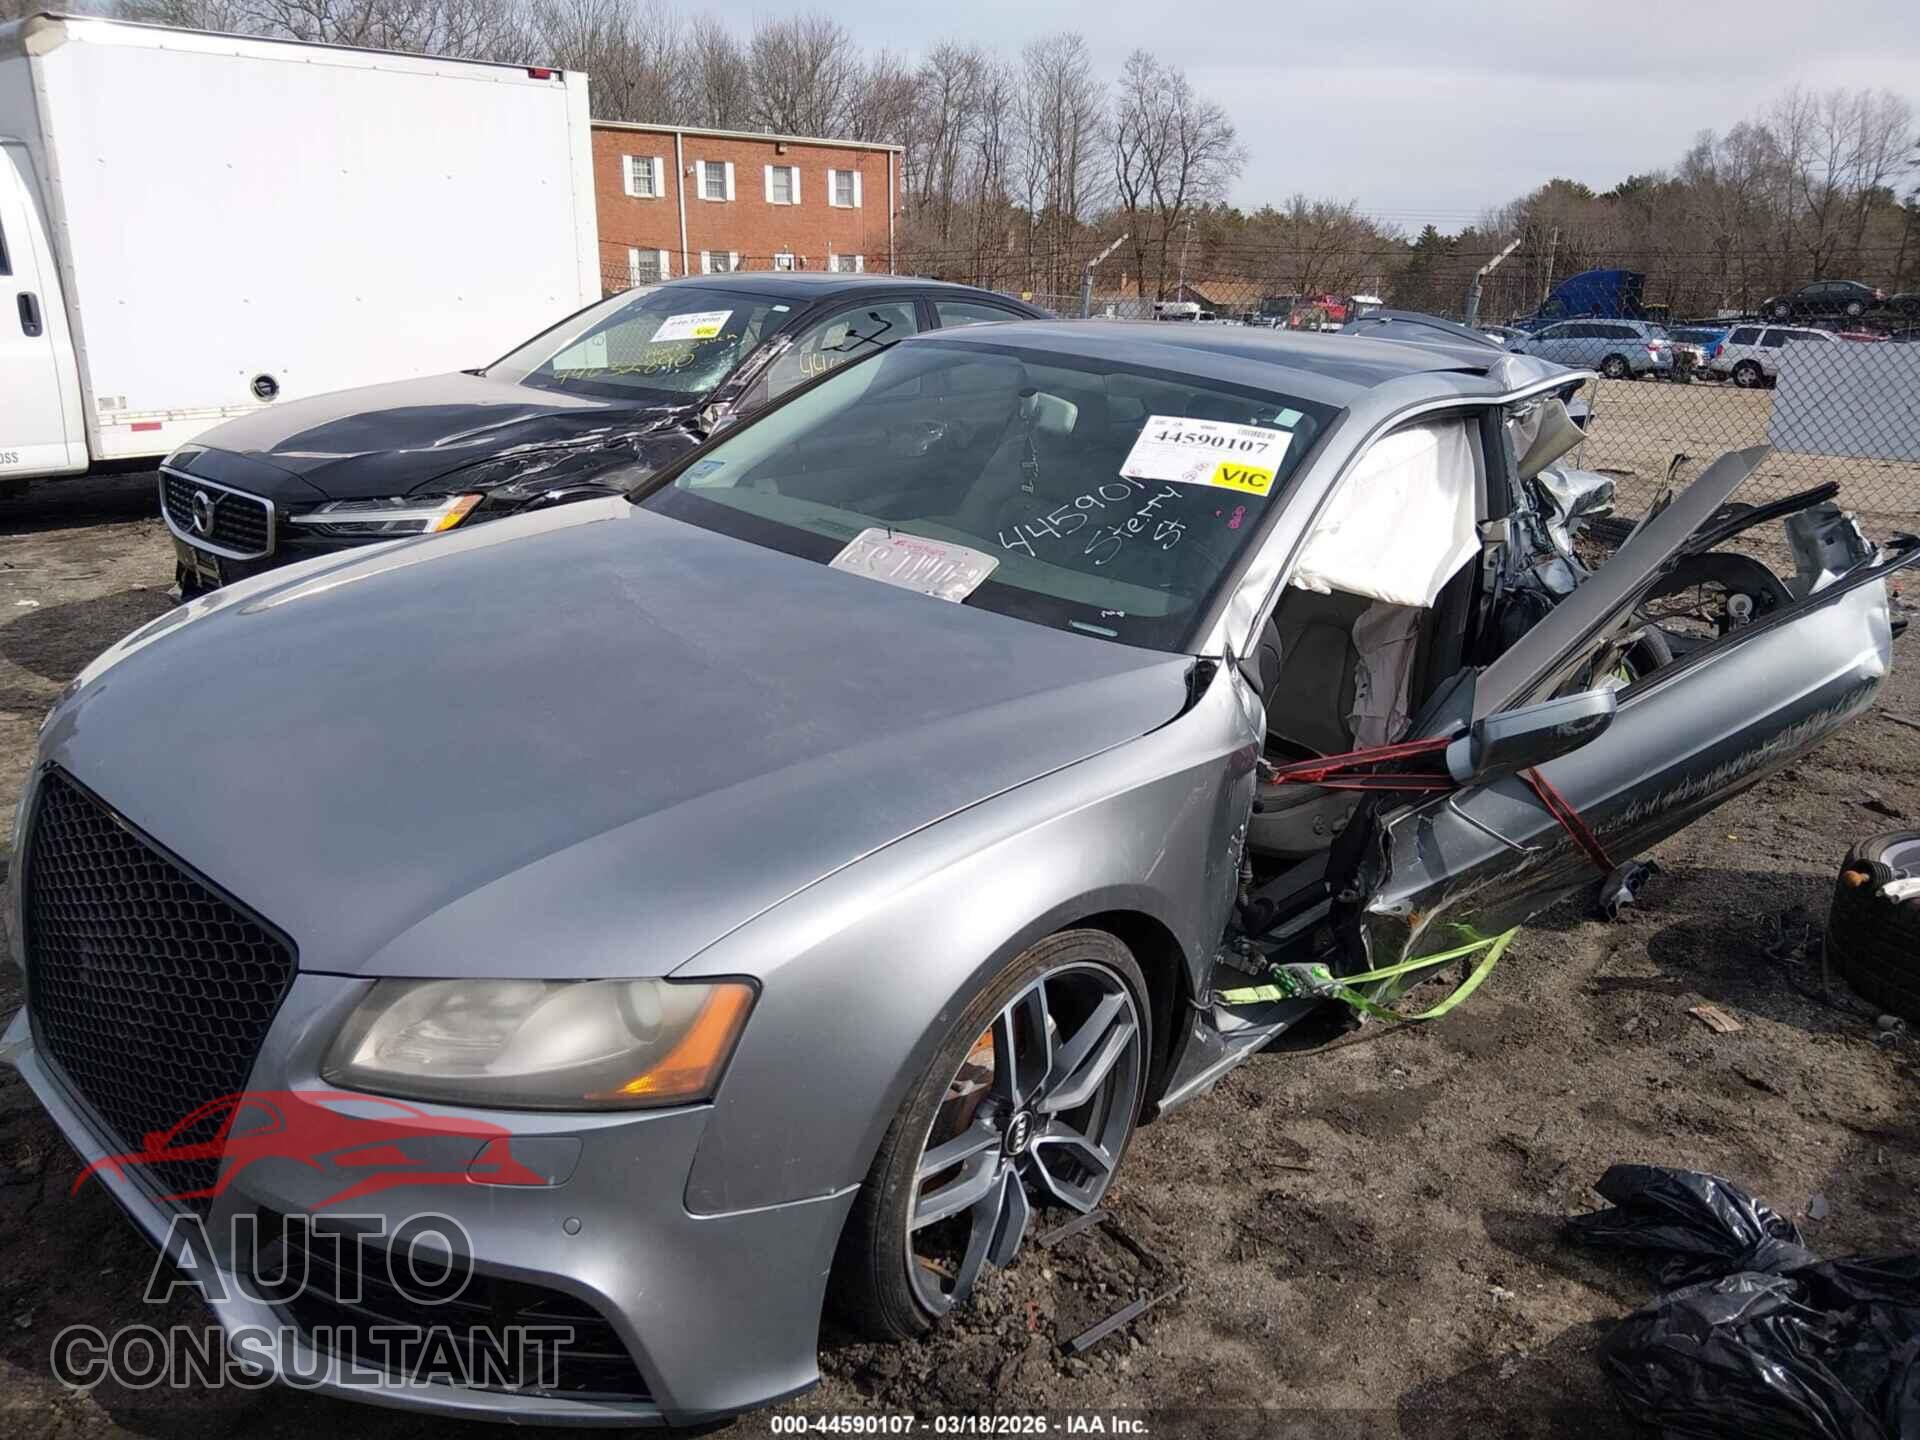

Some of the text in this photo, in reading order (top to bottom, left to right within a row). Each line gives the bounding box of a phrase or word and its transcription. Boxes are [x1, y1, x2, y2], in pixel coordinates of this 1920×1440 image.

[1154, 430, 1269, 454] 44590107
[1221, 467, 1268, 488] VIC
[1153, 518, 1187, 550] St
